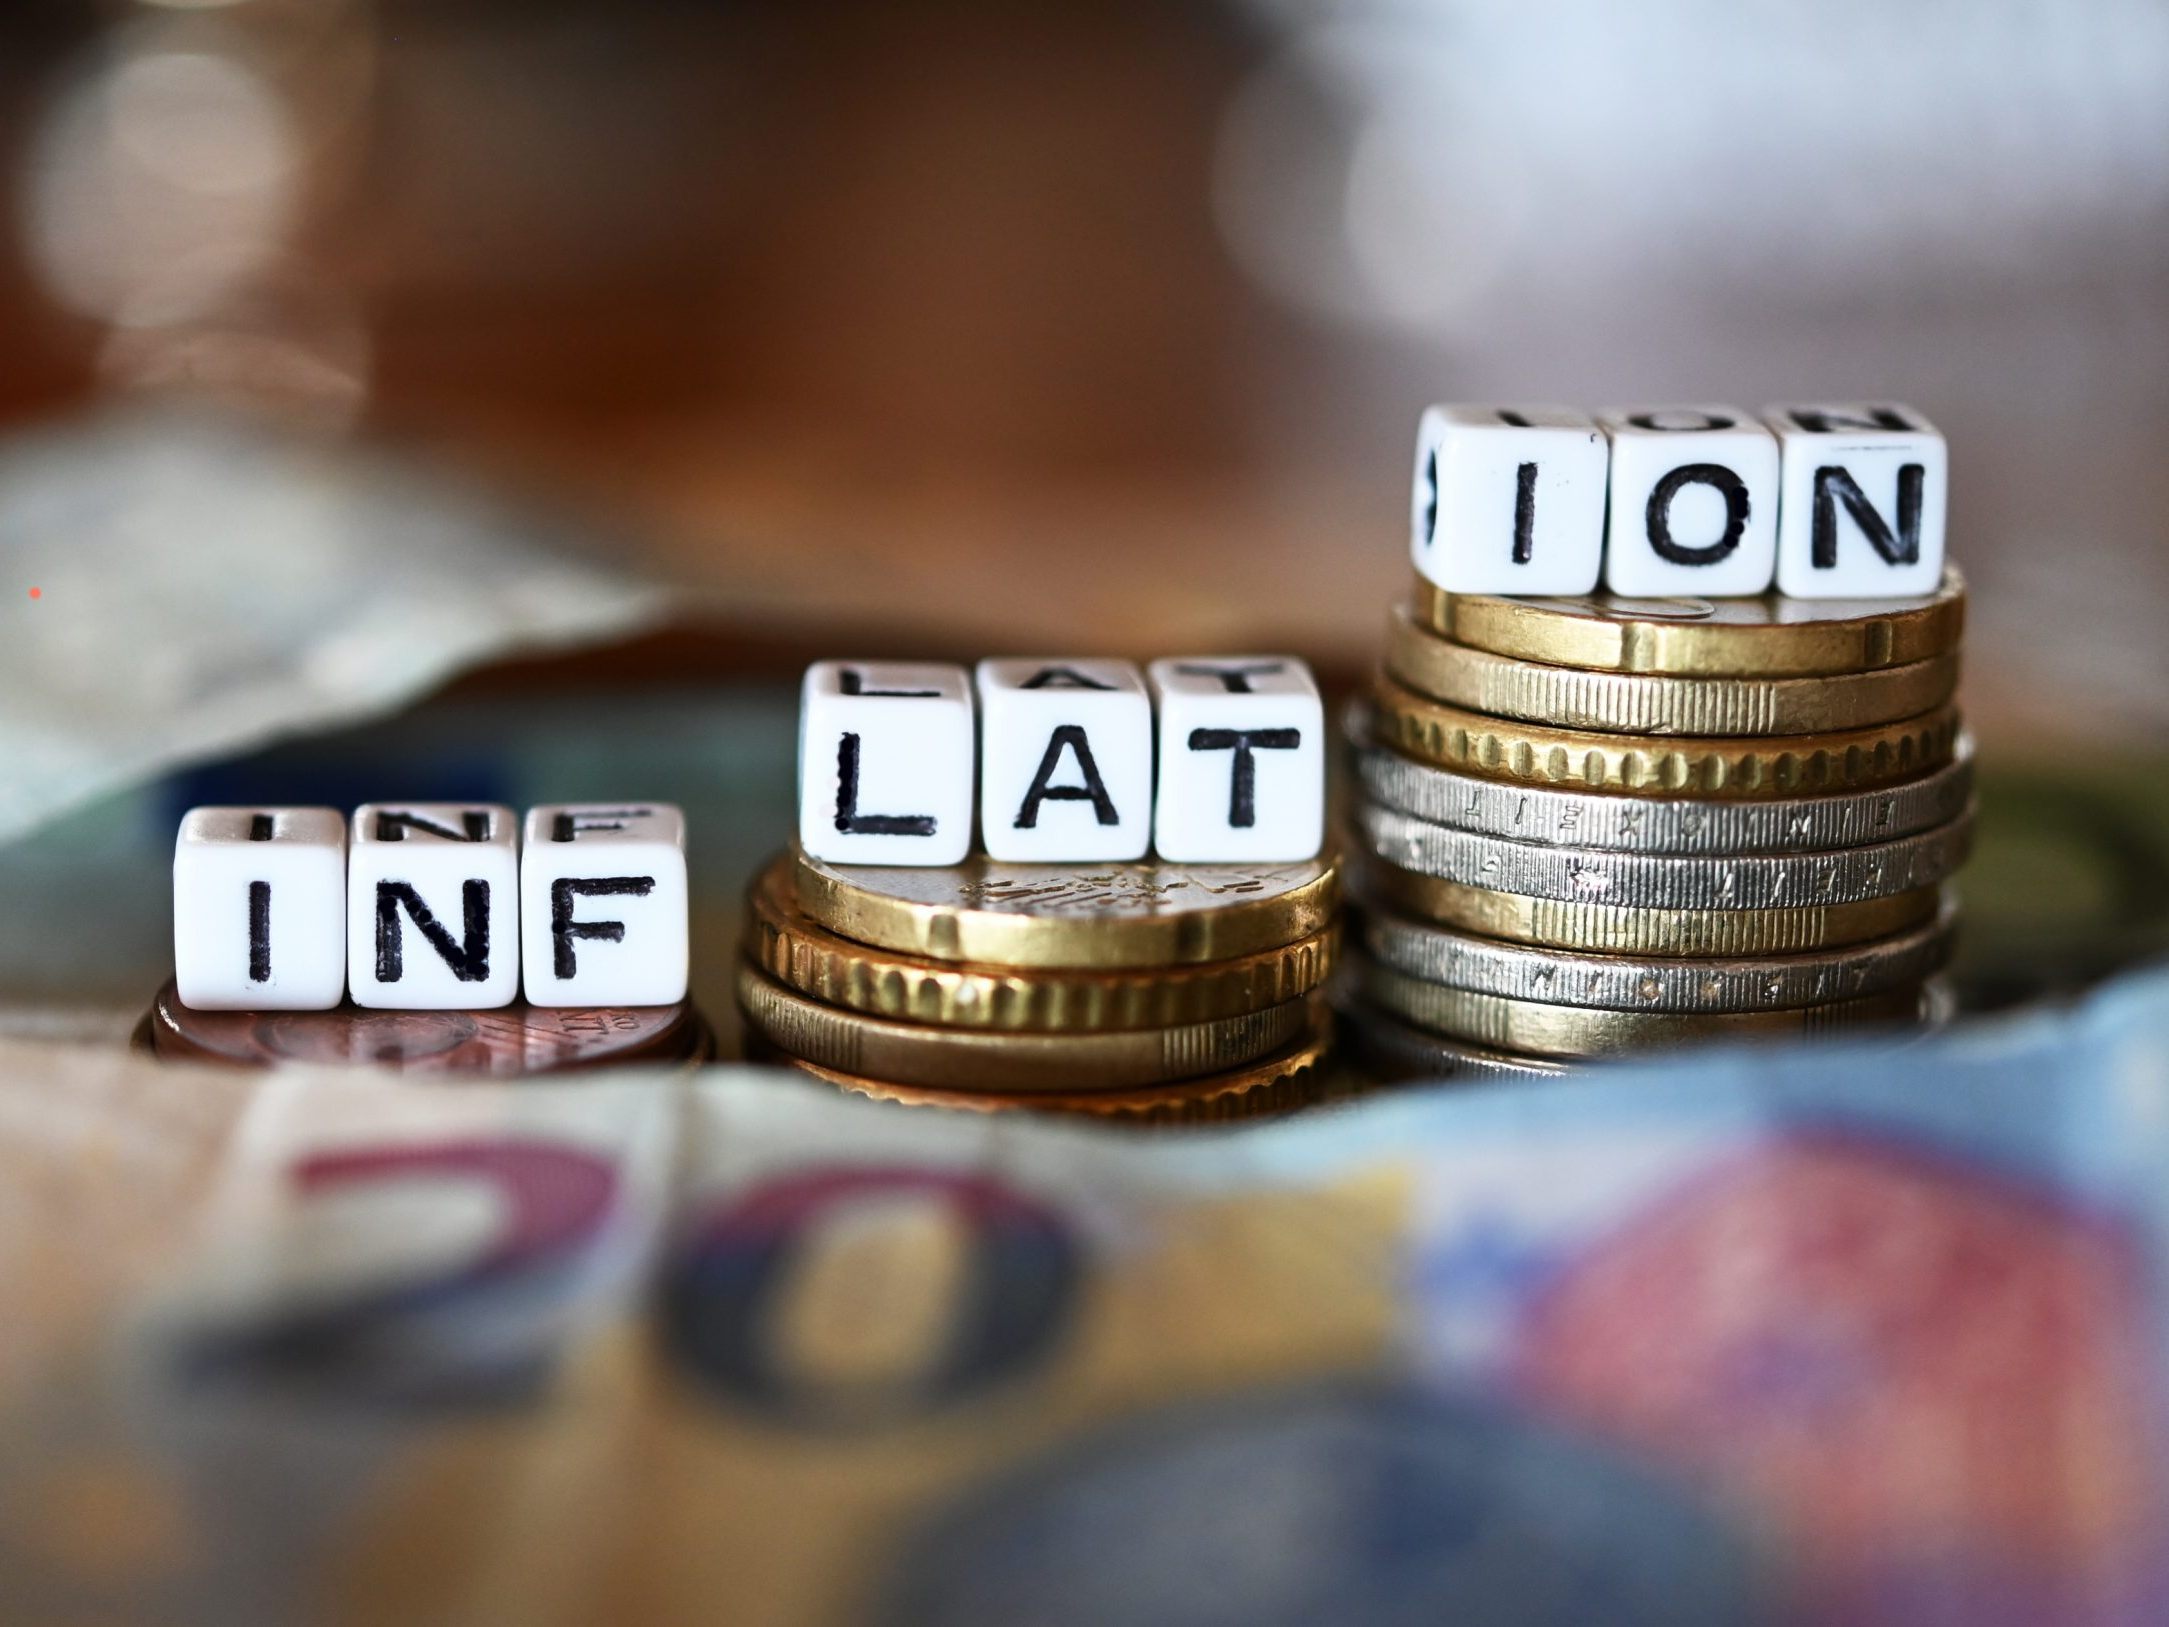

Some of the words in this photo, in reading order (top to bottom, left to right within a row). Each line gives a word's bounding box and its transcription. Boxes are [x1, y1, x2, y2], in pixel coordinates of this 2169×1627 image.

[1511, 461, 1925, 569] ION
[833, 724, 1301, 837] LAT
[249, 875, 656, 983] INF
